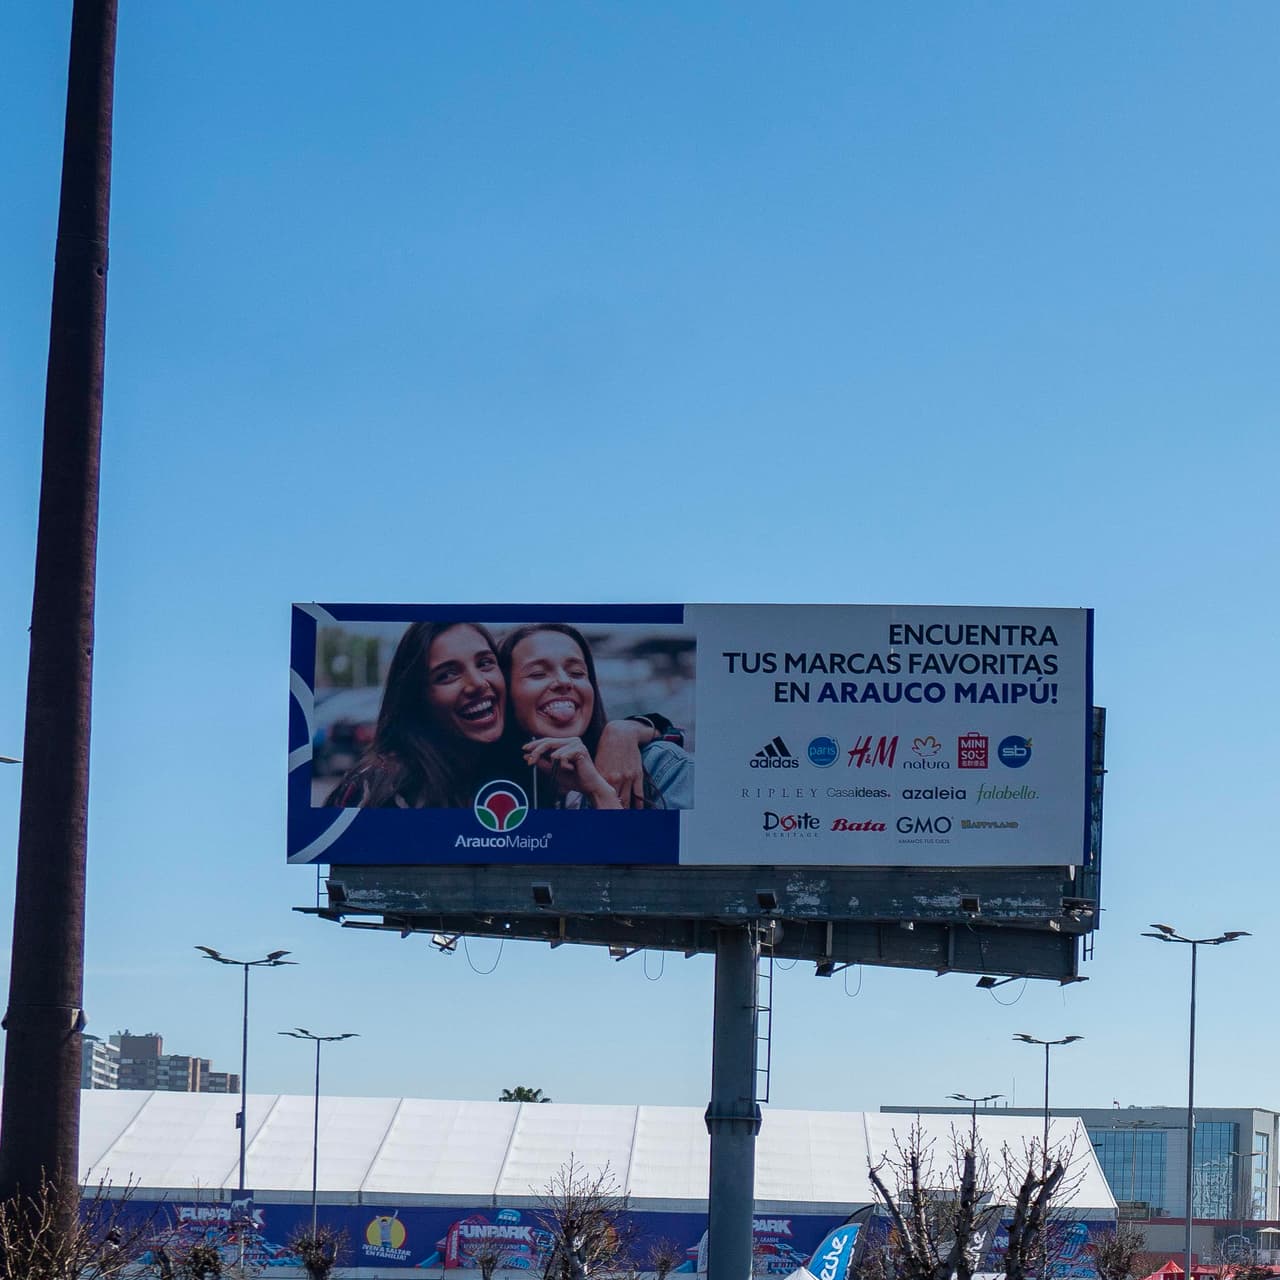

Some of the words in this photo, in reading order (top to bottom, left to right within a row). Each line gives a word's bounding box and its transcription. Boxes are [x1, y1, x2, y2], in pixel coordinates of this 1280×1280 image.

[889, 623, 1059, 646] ENCUENTRA
[722, 651, 777, 674] TUS
[785, 651, 901, 675] MARCAS
[908, 652, 1059, 676] FAVORITAS
[774, 681, 810, 703] EN
[817, 681, 946, 704] ARAUCO
[953, 676, 1059, 705] MAIPÚ!
[808, 745, 836, 758] paris
[961, 739, 985, 749] MINI
[1002, 744, 1027, 757] sb
[847, 735, 899, 769] H&M
[749, 757, 800, 769] adidas
[903, 758, 950, 770] natura
[741, 787, 819, 799] RIPLEY
[902, 786, 967, 801] azaleia
[830, 817, 888, 832] Bata
[896, 816, 952, 834] GMO
[753, 1219, 792, 1235] PARK
